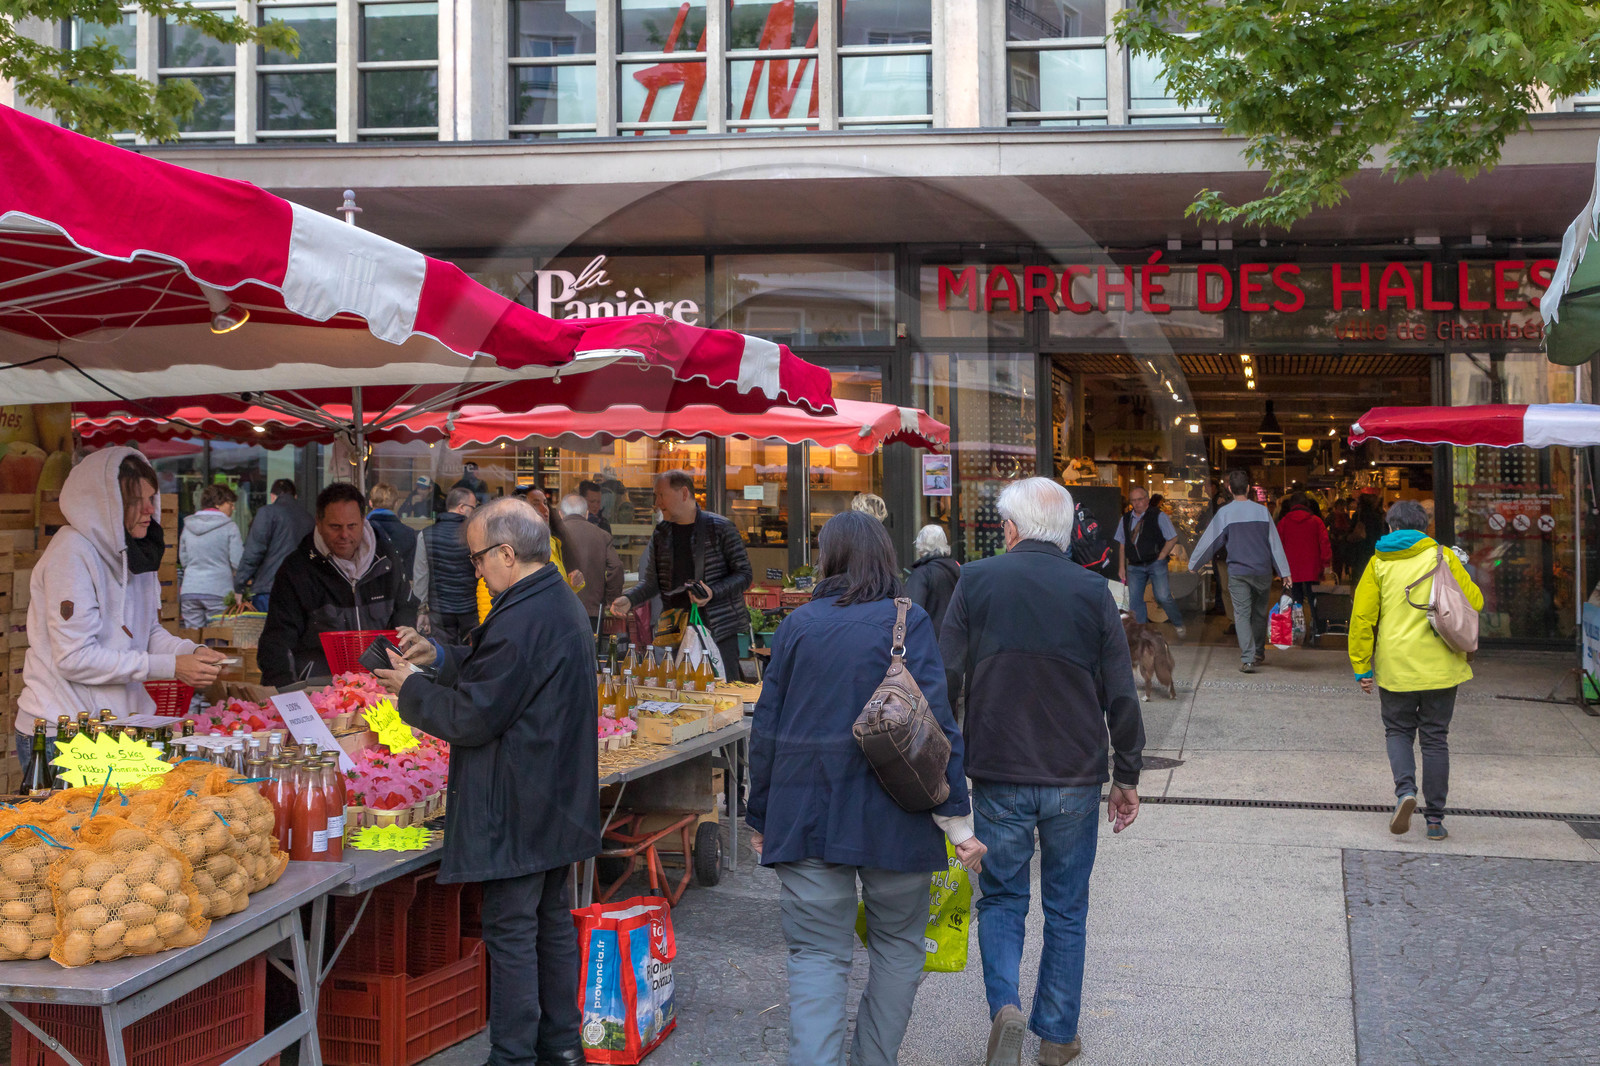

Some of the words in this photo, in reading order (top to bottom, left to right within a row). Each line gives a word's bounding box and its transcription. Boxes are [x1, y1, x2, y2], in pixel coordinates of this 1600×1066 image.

[633, 0, 819, 136] HM
[568, 254, 611, 291] la
[937, 249, 1171, 313] MARCHÉ
[1196, 262, 1306, 313] DES
[1332, 259, 1559, 312] HALLES
[534, 270, 699, 326] Panière
[1334, 320, 1388, 341] ville
[1396, 320, 1428, 341] de
[286, 702, 302, 712] 100%
[70, 747, 98, 760] Sac
[593, 939, 606, 1009] provencia.fr
